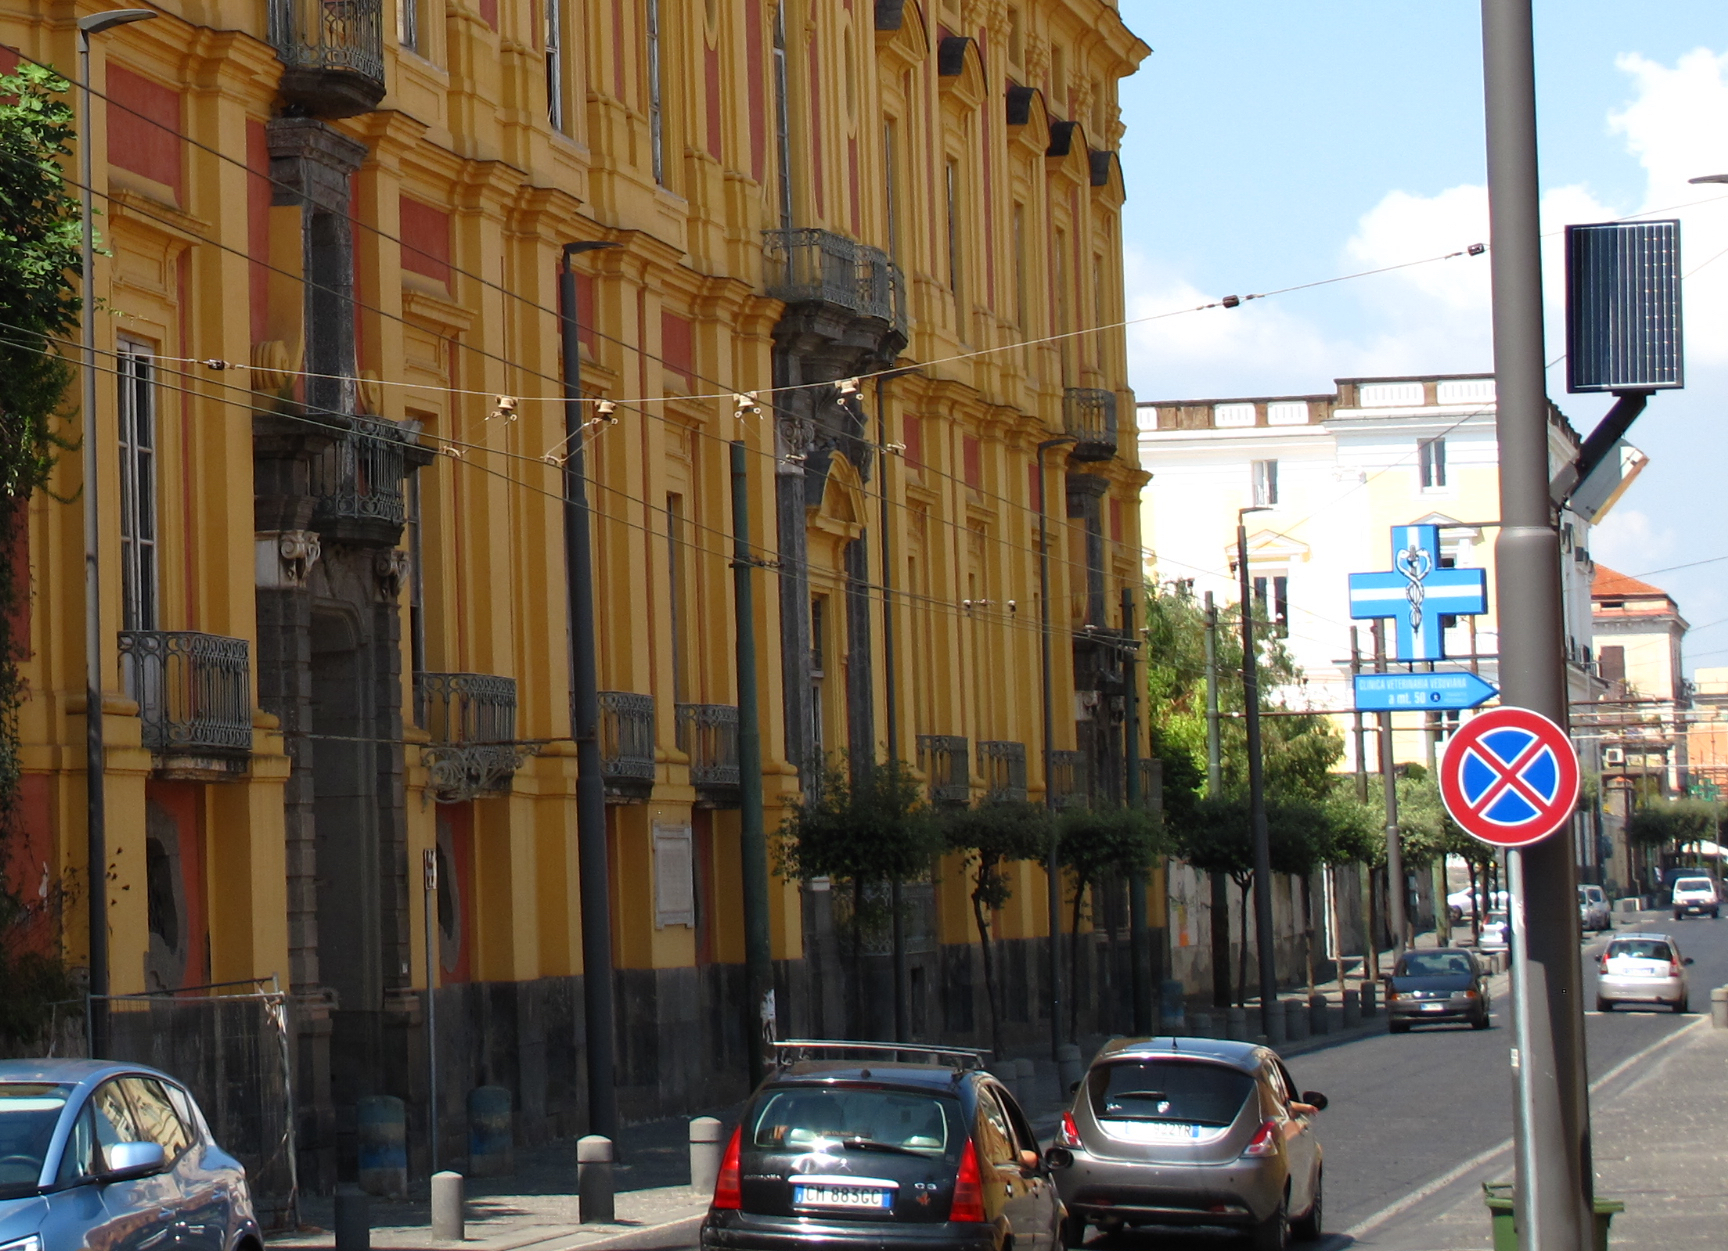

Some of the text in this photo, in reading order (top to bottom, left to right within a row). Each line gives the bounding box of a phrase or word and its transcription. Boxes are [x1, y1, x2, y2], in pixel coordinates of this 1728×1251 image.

[1358, 677, 1467, 690] CLINICA VETERINARIA VESUVIANA
[1388, 691, 1426, 705] a mt. 50
[805, 1185, 826, 1202] CM
